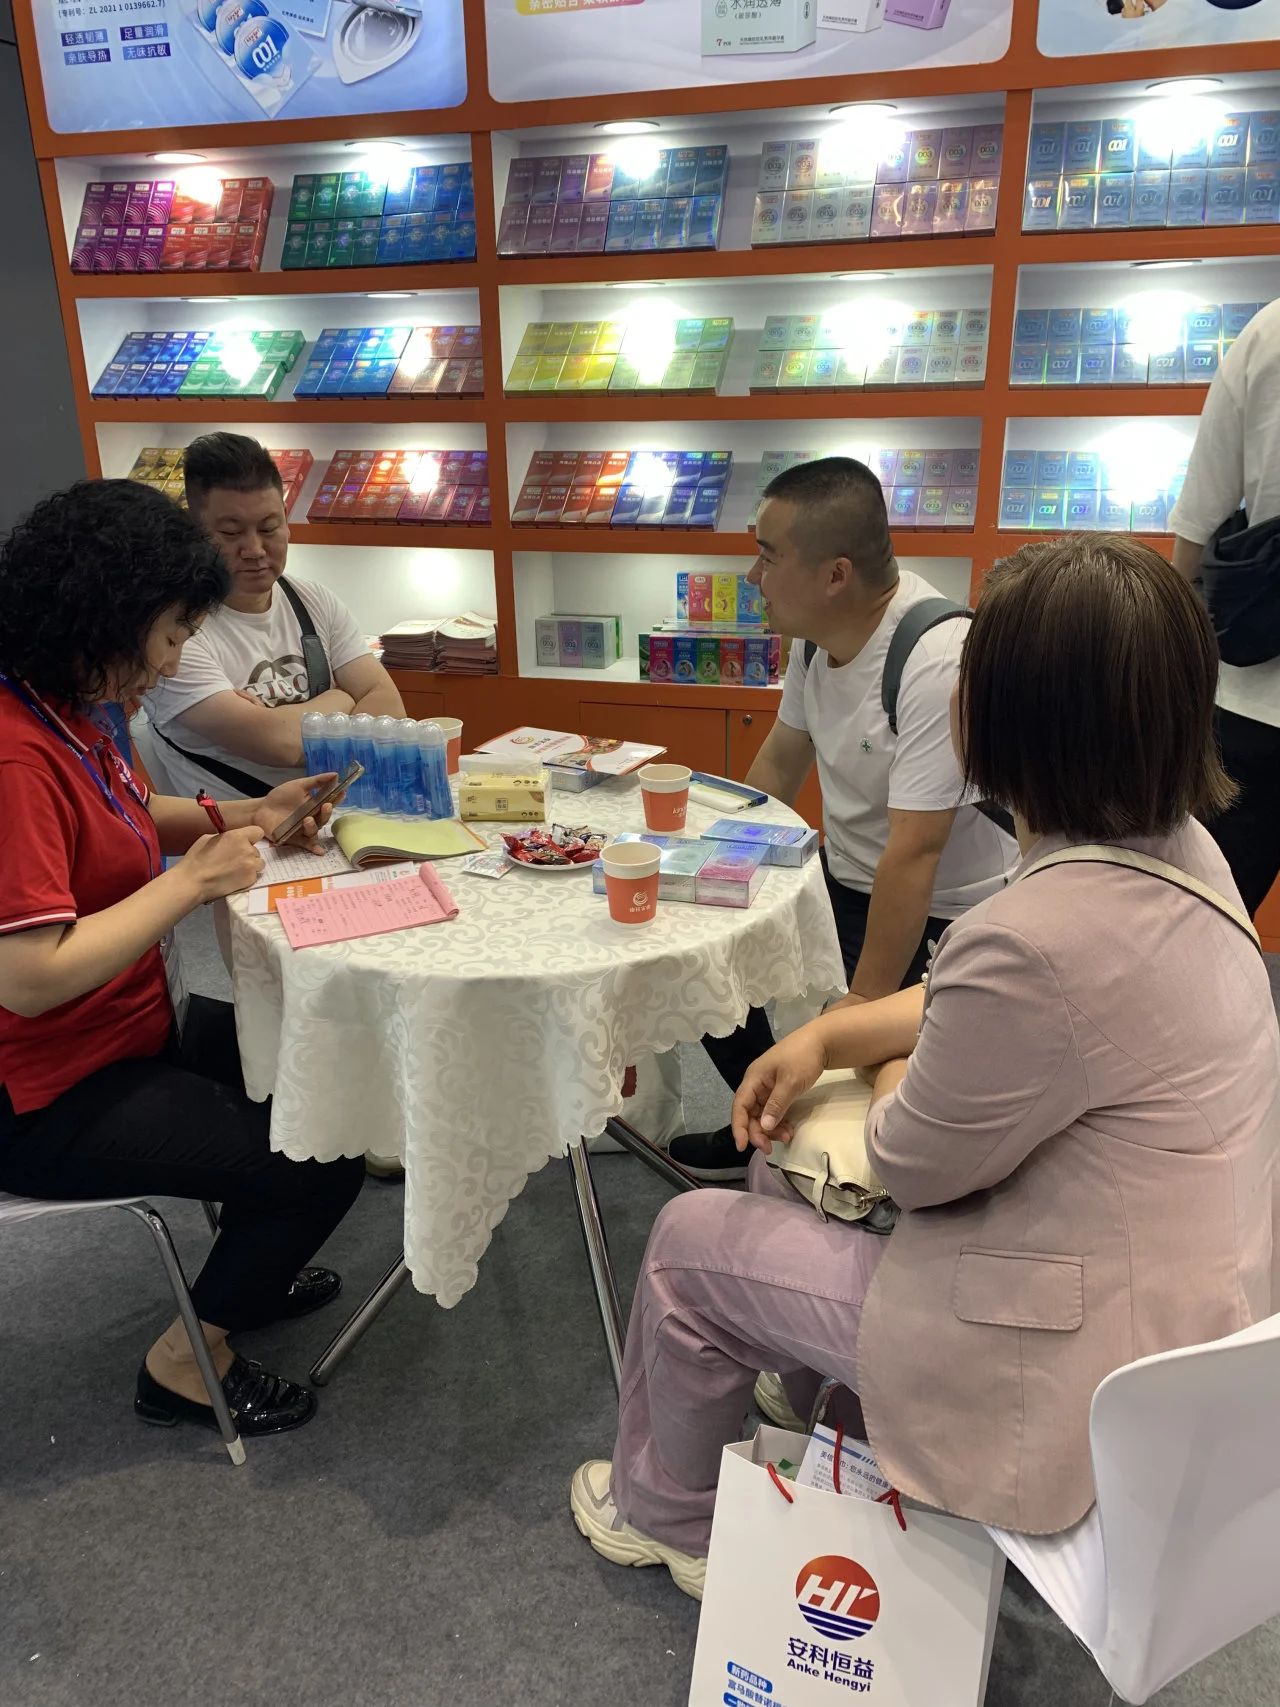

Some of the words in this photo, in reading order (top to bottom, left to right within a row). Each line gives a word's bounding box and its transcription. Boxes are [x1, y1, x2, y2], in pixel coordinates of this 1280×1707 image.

[89, 6, 98, 14] ZL
[100, 5, 117, 13] 2021
[124, 25, 165, 39] 足量润滑
[68, 50, 108, 65] 亲肤导热
[127, 44, 168, 58] 无味抗敏
[787, 1638, 874, 1680] 安科恒益
[731, 1664, 768, 1690] 新药品种
[787, 1658, 820, 1677] Anke
[824, 1669, 871, 1692] Hengyi
